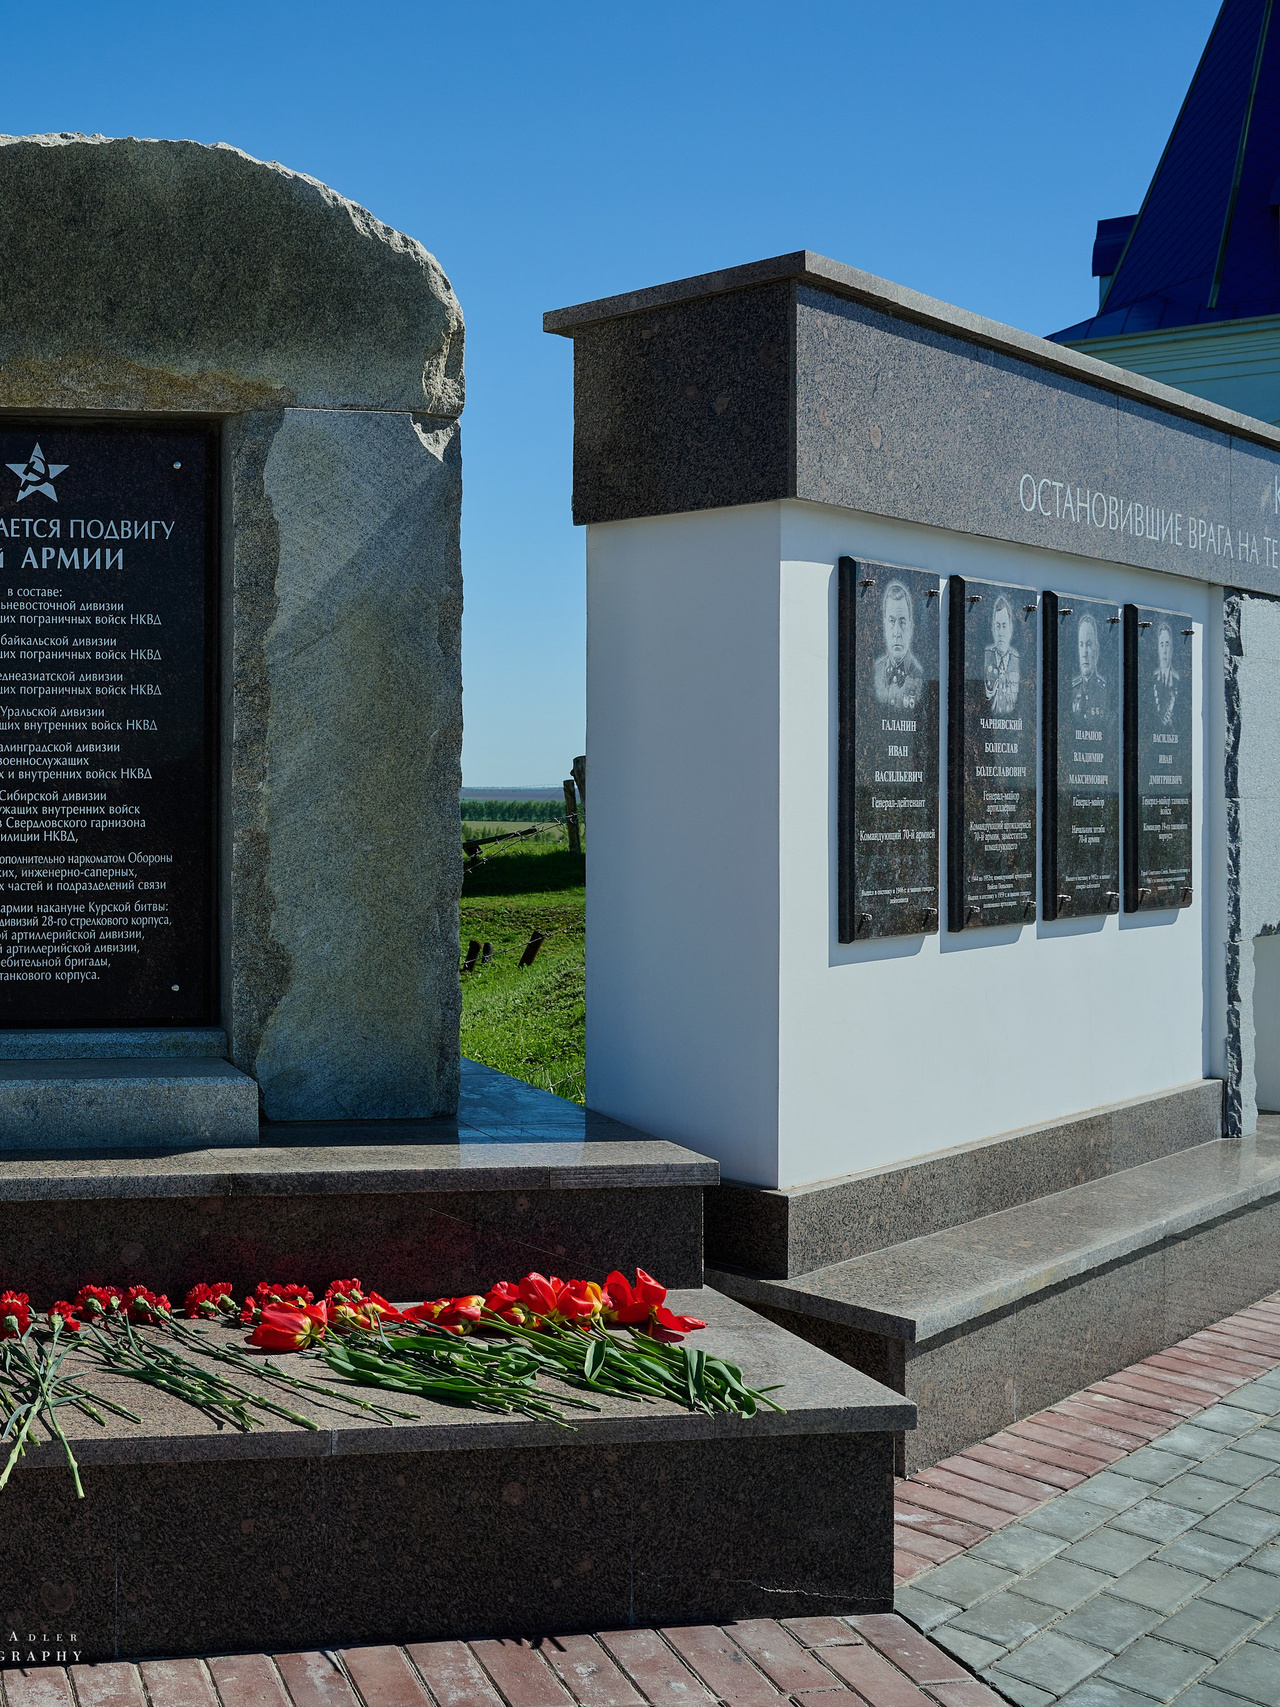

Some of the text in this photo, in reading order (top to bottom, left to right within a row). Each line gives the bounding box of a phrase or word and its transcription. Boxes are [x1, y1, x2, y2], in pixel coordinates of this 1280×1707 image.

[1020, 474, 1182, 546] ОСТАНОВИВШИЕ
[1189, 517, 1233, 558] ВРАГА
[1238, 530, 1259, 564] НА
[70, 519, 174, 539] ПОДВИГУ
[21, 547, 124, 570] АРМИИ
[7, 588, 62, 596] в составе:
[79, 602, 123, 610] дивизии
[19, 615, 91, 626] пограничных
[95, 613, 126, 624] войск
[130, 613, 161, 624] НКВД
[72, 638, 116, 646] дивизии
[19, 650, 91, 661] пограничных
[95, 648, 126, 659] войск
[130, 648, 161, 659] НКВД
[78, 673, 122, 681] дивизии
[20, 686, 91, 696] пограничных
[95, 683, 126, 694] войск
[130, 684, 161, 694] НКВД
[0, 706, 56, 718] Уральской
[60, 708, 104, 716] дивизии
[24, 722, 87, 732] внутренних
[91, 719, 122, 729] войск
[126, 719, 157, 729] НКВД
[882, 720, 916, 731] ГАЛАНИН
[980, 718, 1022, 730] ЧАРНЯВСКИЙ
[1075, 730, 1102, 741] ШАРАПОВ
[1153, 733, 1178, 744] ВАСИЛЬЕВ
[75, 744, 119, 752] дивизии
[888, 745, 908, 756] ИВАН
[985, 743, 1018, 753] БОЛЕСЛАВ
[1073, 752, 1104, 763] ВЛАДИМИР
[18, 770, 81, 780] внутренних
[85, 768, 116, 778] войск
[120, 768, 152, 778] НКВД
[875, 771, 923, 782] ВАСИЛЬЕВИЧ
[976, 766, 1026, 776] БОЛЕСЛАВОВИЧ
[1069, 774, 1108, 785] МАКСИМОВИЧ
[62, 792, 106, 800] дивизии
[42, 806, 105, 816] внутренних
[109, 803, 140, 814] войск
[6, 816, 87, 830] Свердловского
[90, 818, 145, 829] гарнизона
[43, 830, 78, 843] НКВД,
[68, 855, 125, 865] наркоматом
[128, 852, 172, 865] Обороны
[21, 868, 137, 879] инженерно-саперных,
[8, 880, 42, 890] частей
[46, 882, 52, 890] и
[56, 879, 134, 892] подразделений
[137, 881, 166, 889] связи
[0, 904, 32, 914] армии
[35, 904, 85, 914] накануне
[88, 901, 130, 914] Курской
[134, 901, 168, 911] битвы:
[41, 915, 67, 926] 28-го
[69, 917, 128, 928] стрелкового
[131, 917, 171, 927] корпуса,
[11, 928, 95, 942] артиллерийской
[99, 931, 144, 941] дивизии,
[6, 942, 90, 955] артиллерийской
[94, 944, 139, 954] дивизии,
[64, 956, 110, 968] бригады,
[55, 971, 99, 982] корпуса.
